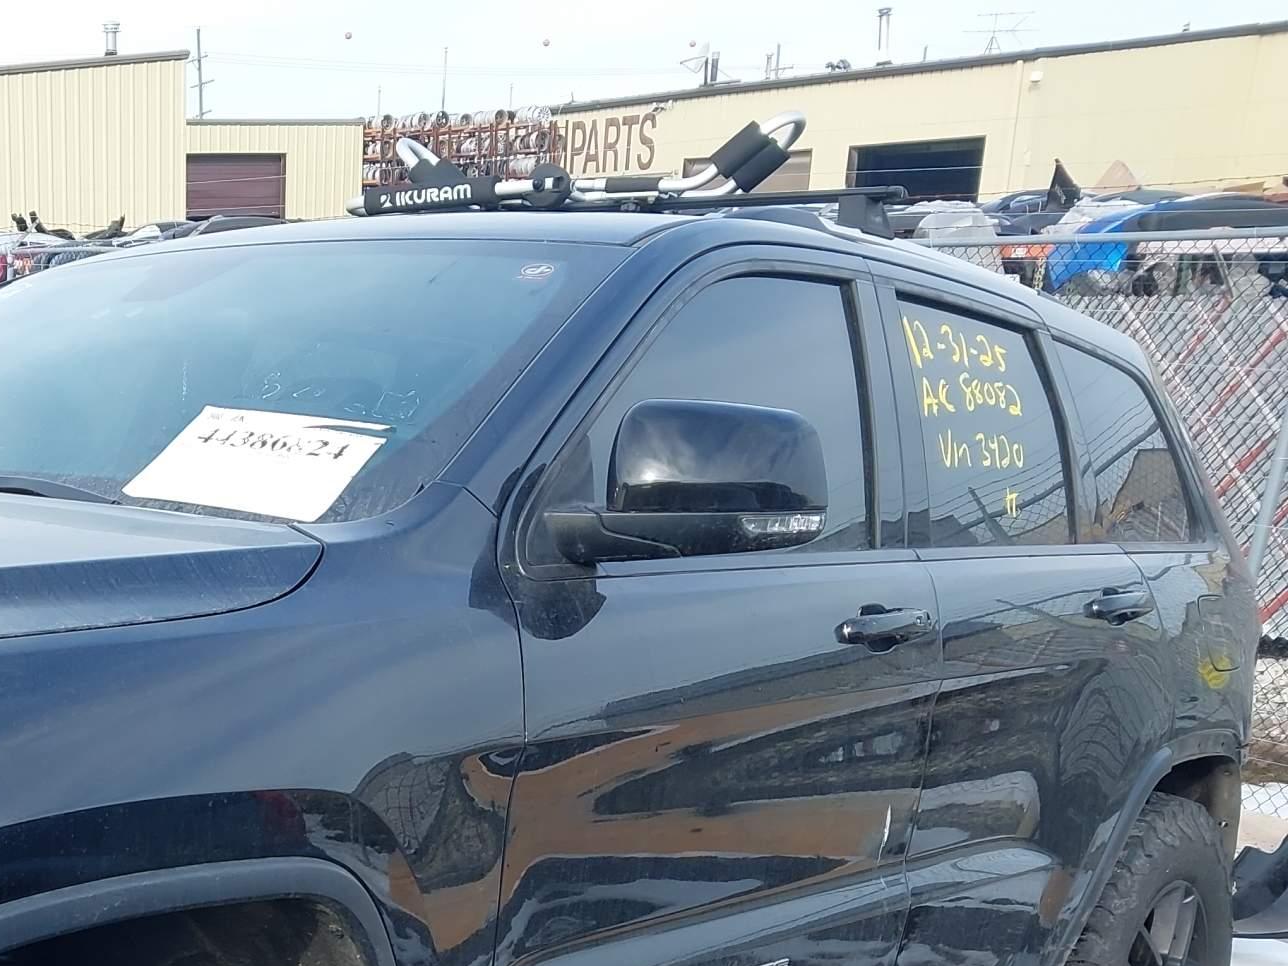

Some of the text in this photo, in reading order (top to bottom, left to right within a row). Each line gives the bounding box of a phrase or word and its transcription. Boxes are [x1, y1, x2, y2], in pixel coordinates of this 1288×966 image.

[395, 183, 472, 207] IKURAM
[903, 316, 1007, 372] 12-31-25
[959, 372, 1022, 416] 88082
[975, 432, 1024, 469] 3420
